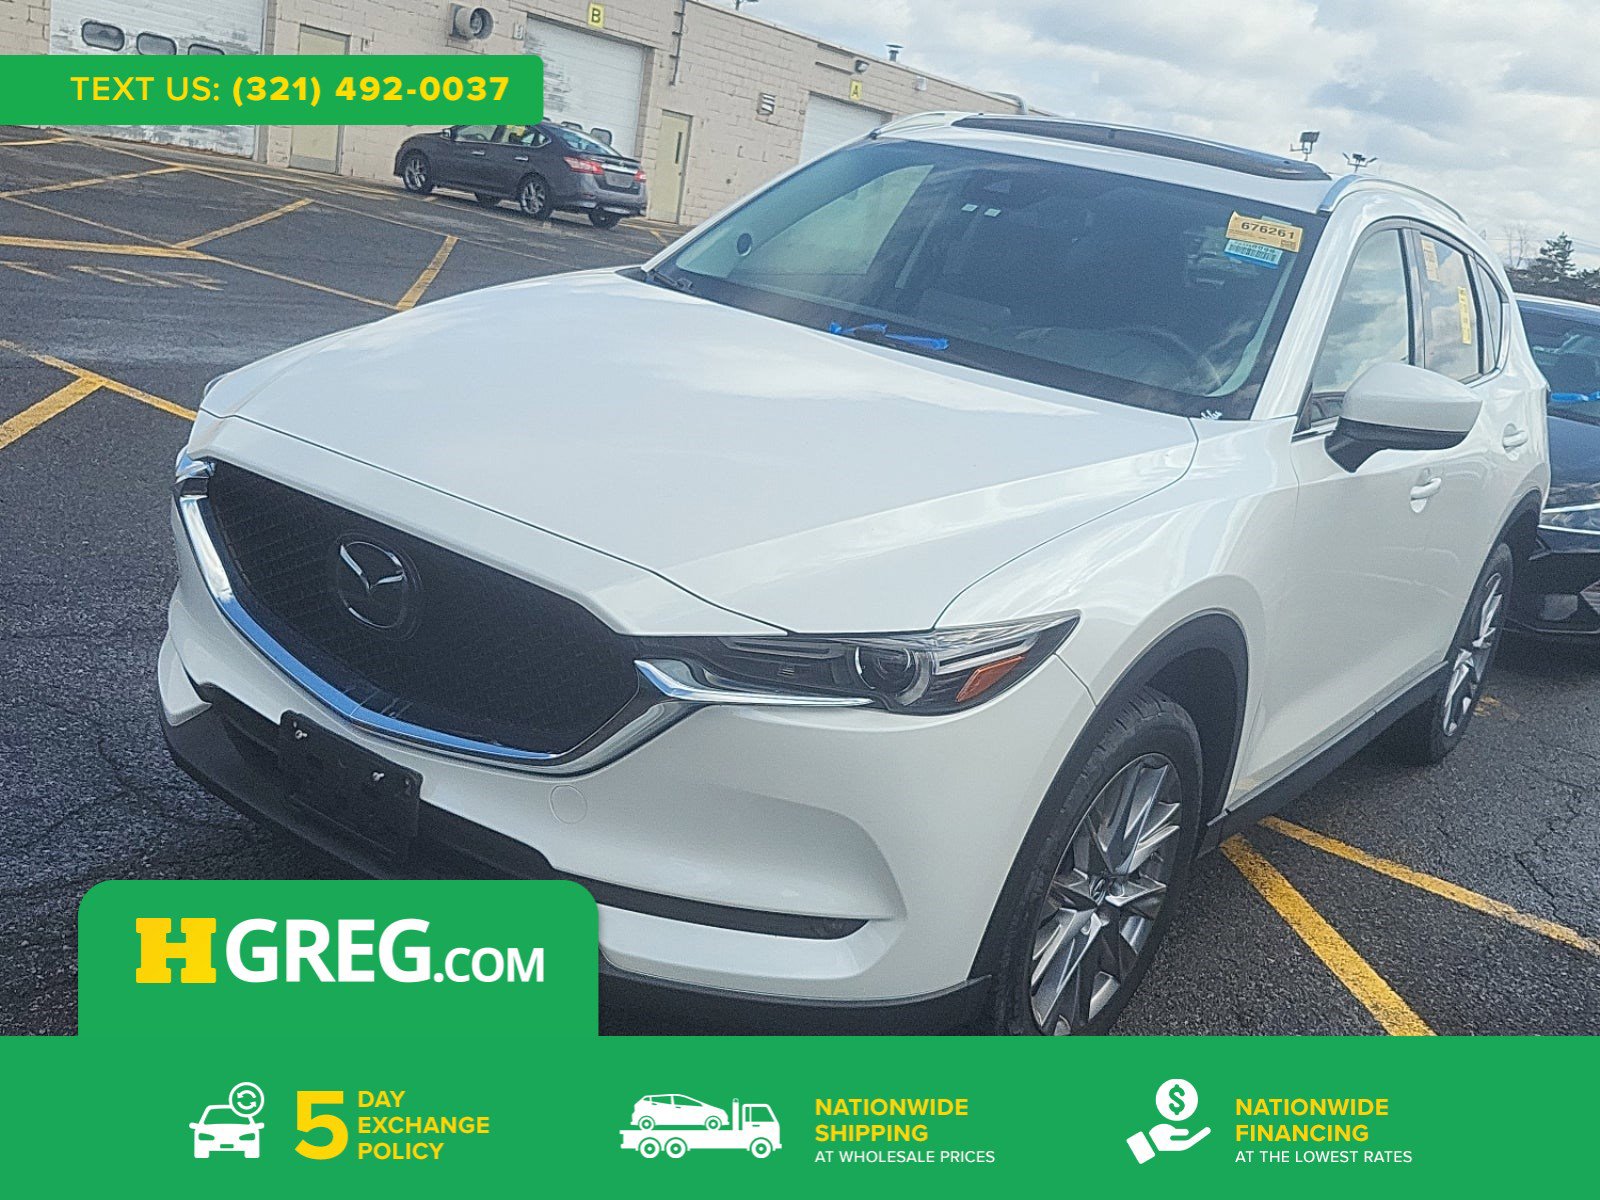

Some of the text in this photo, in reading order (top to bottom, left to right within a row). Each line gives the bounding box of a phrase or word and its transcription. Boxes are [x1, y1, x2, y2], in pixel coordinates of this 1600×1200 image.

[591, 7, 601, 23] B
[851, 85, 860, 99] A
[1241, 221, 1295, 239] 676261
